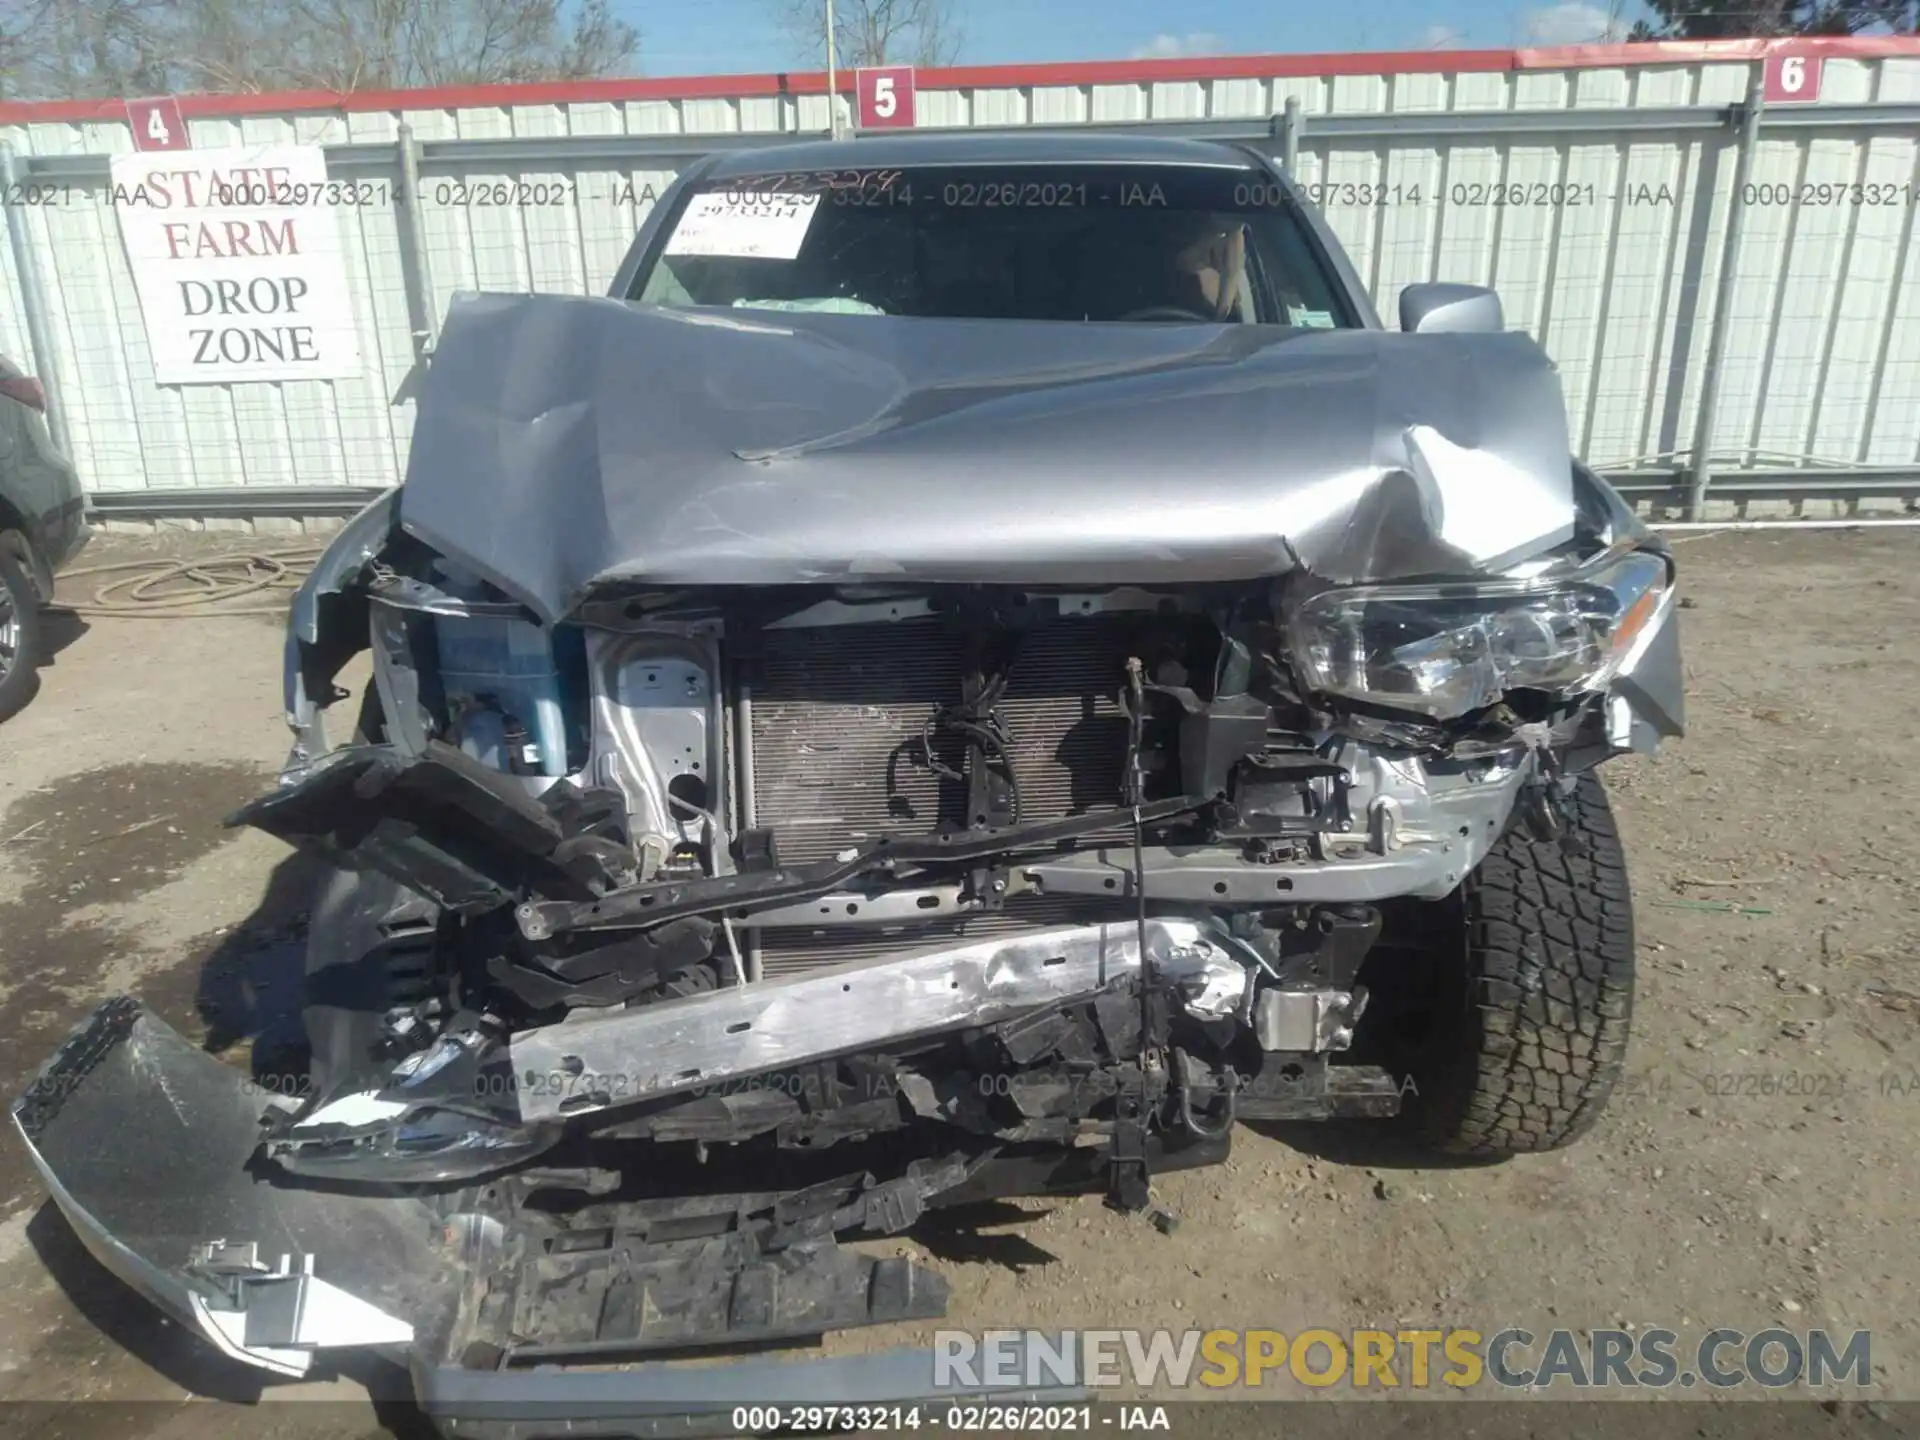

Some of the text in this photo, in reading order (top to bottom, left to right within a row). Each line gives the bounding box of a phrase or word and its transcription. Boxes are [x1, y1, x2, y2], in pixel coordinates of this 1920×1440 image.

[1781, 57, 1805, 92] 6
[874, 77, 896, 118] 5
[147, 107, 169, 144] 4
[146, 167, 293, 209] STATE
[162, 218, 300, 260] FARM
[177, 276, 308, 316] DROP
[189, 326, 320, 365] ZONE
